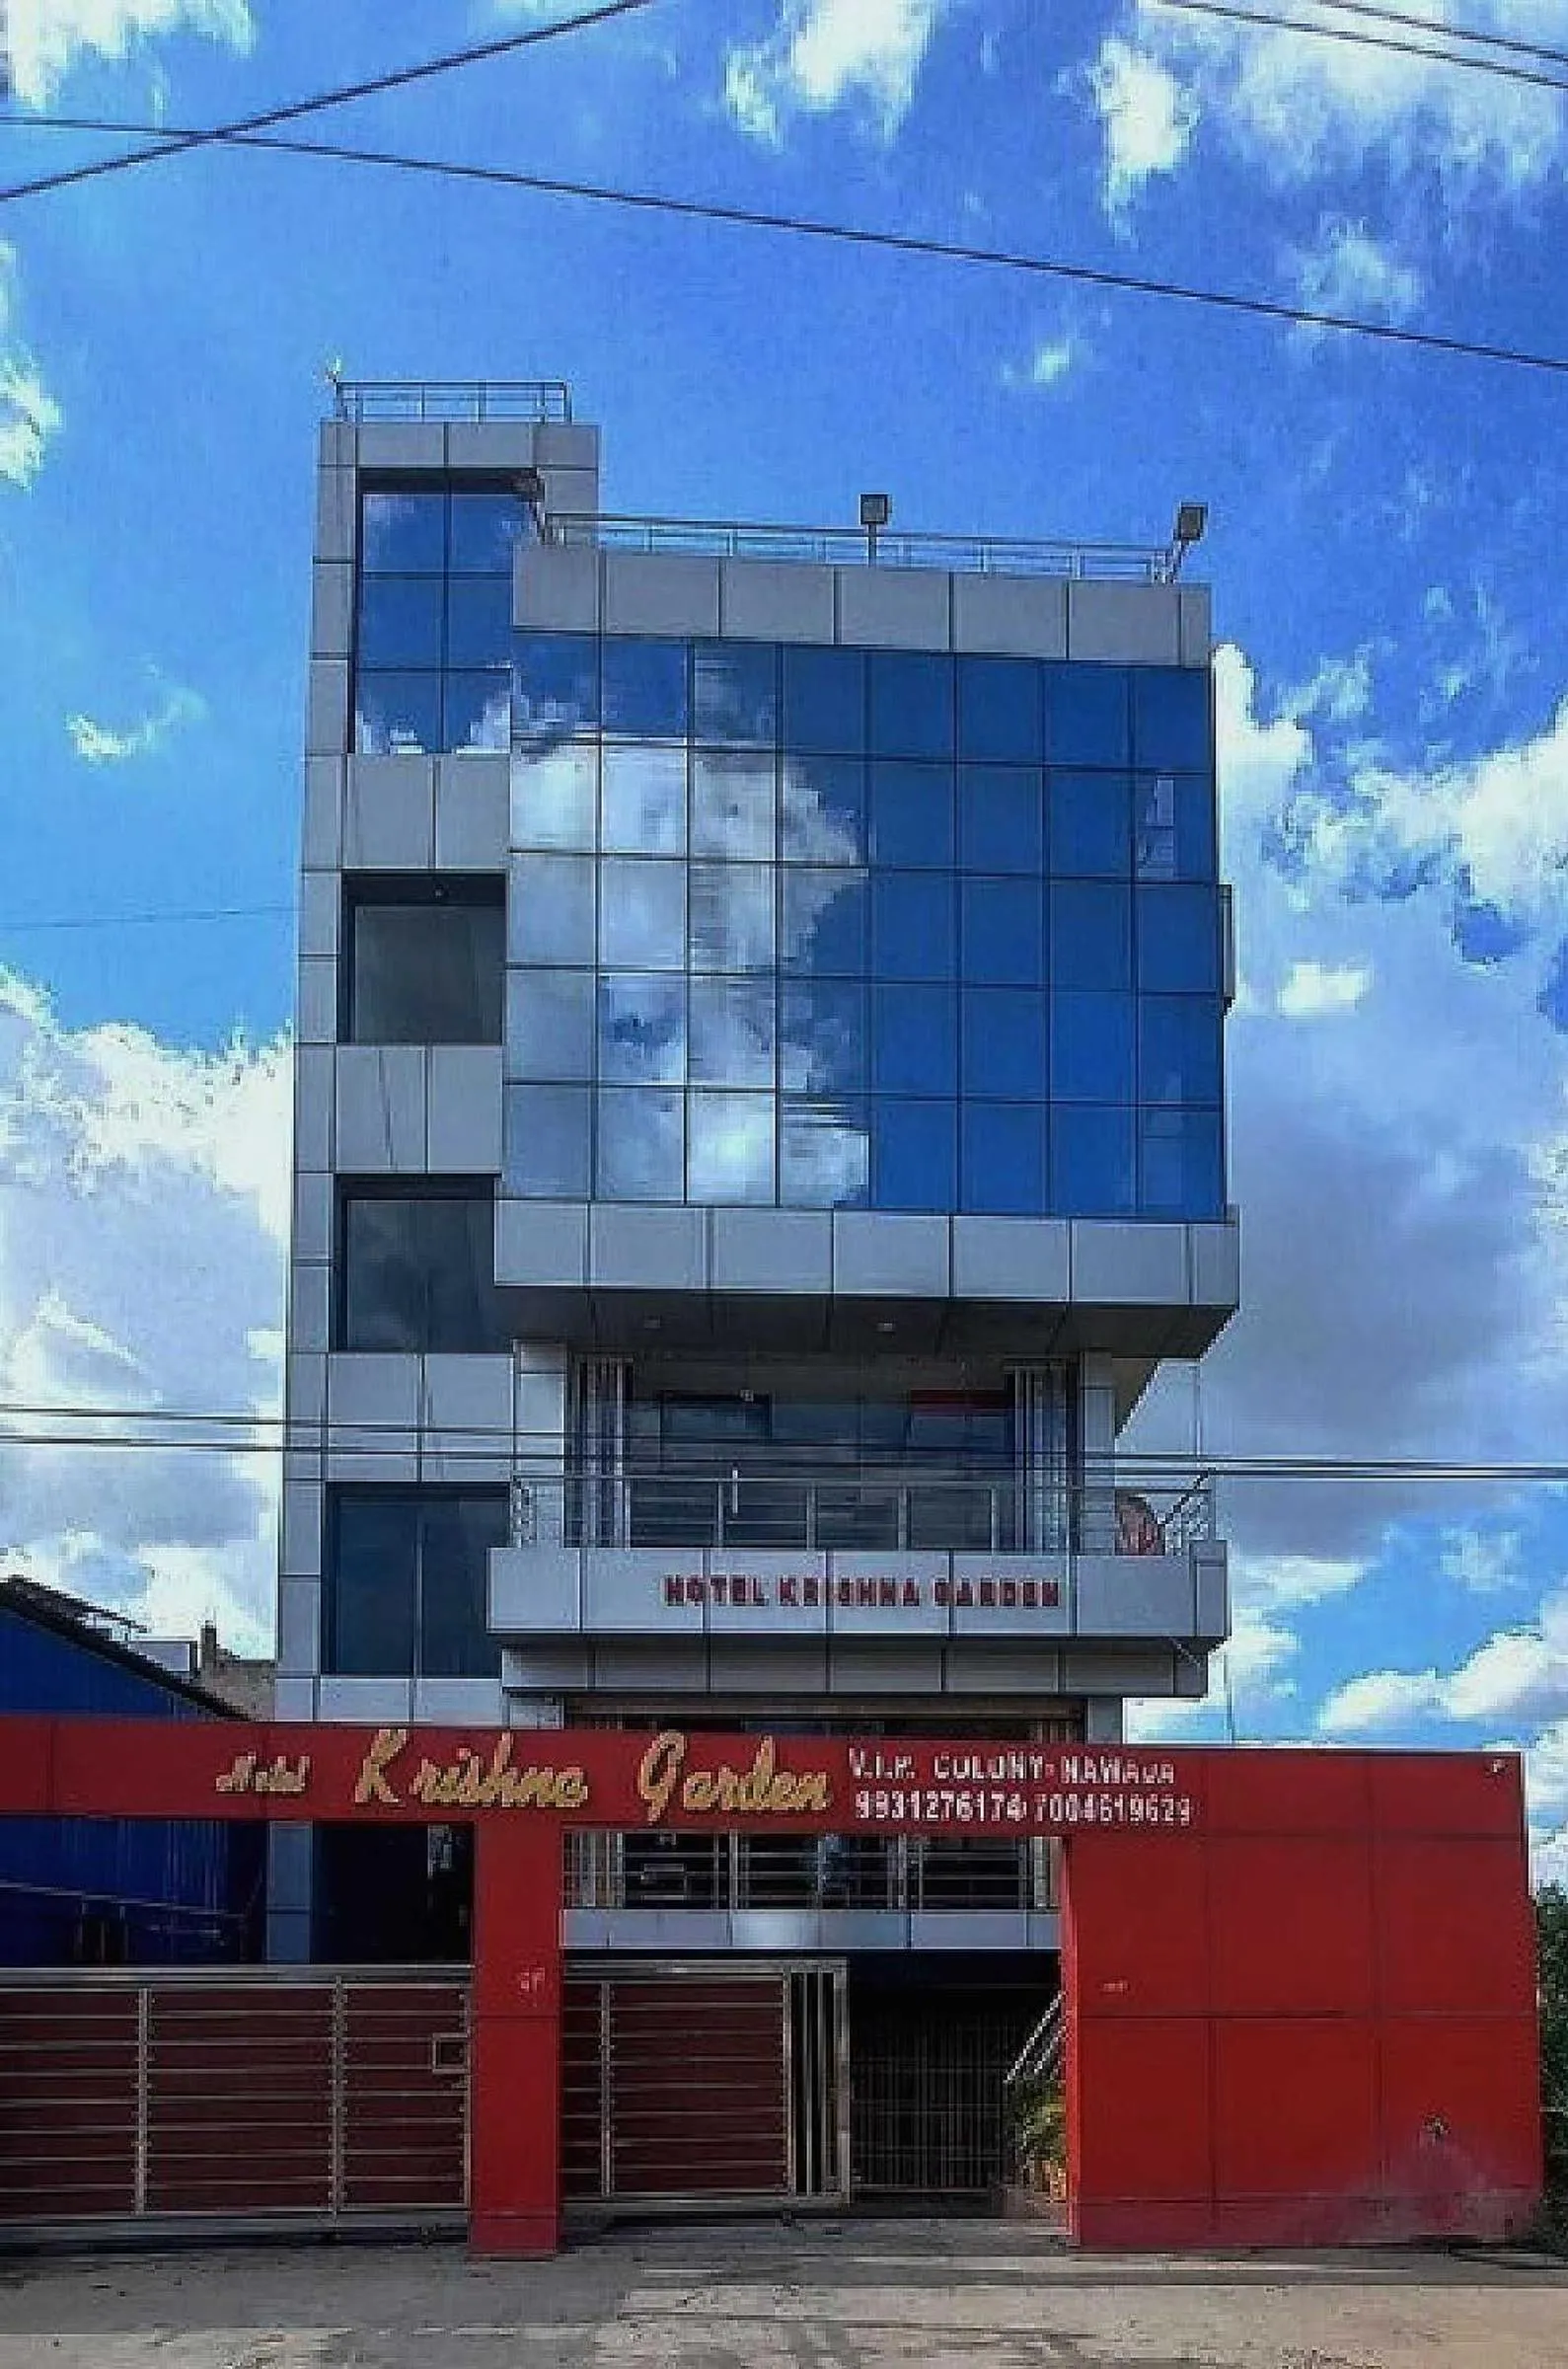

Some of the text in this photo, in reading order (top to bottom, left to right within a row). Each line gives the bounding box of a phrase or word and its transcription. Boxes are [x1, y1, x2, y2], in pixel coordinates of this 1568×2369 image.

[665, 1575, 1061, 1607] HOTEL KRISHNA GARDEN
[354, 1728, 588, 1807] Krishna
[640, 1730, 828, 1822] Garden
